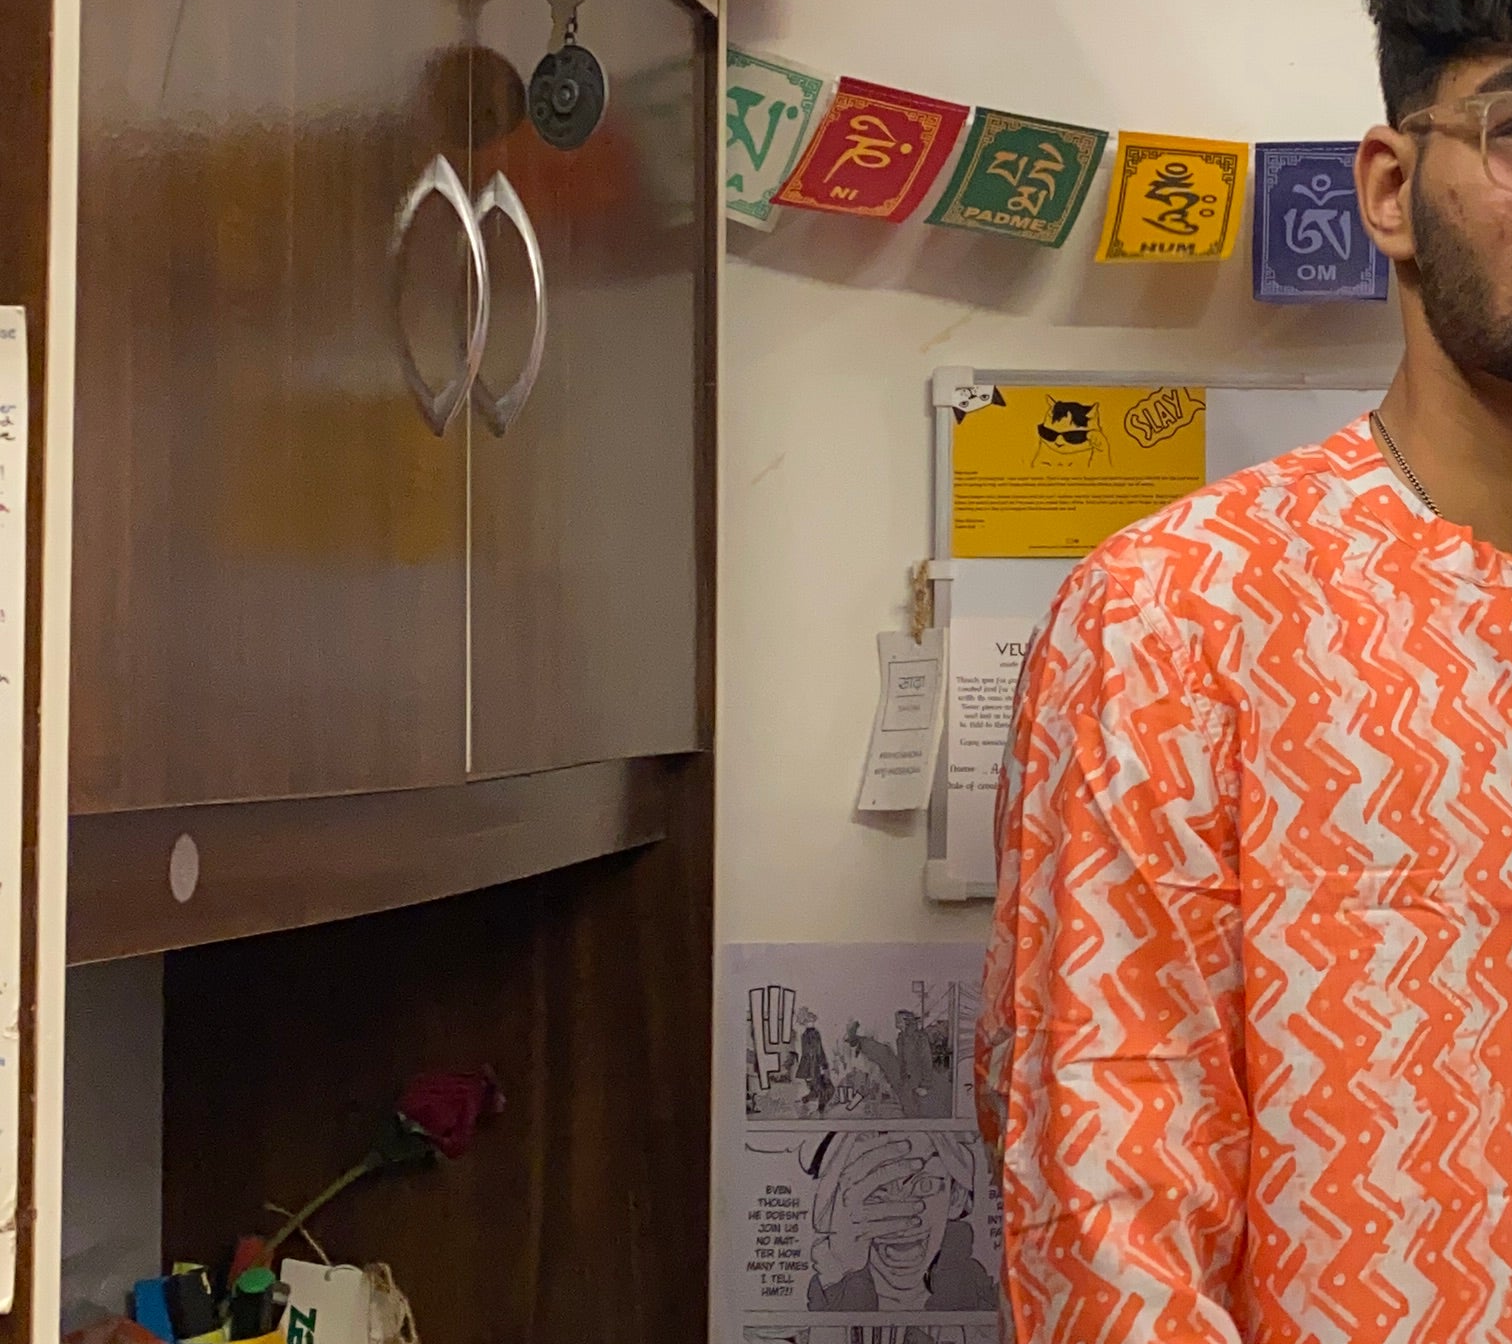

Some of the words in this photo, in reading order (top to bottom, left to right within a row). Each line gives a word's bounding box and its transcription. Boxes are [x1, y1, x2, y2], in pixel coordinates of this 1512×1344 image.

[829, 185, 859, 200] NI
[961, 205, 1047, 232] PADME
[1296, 264, 1337, 281] OM
[1130, 389, 1186, 441] SLAY
